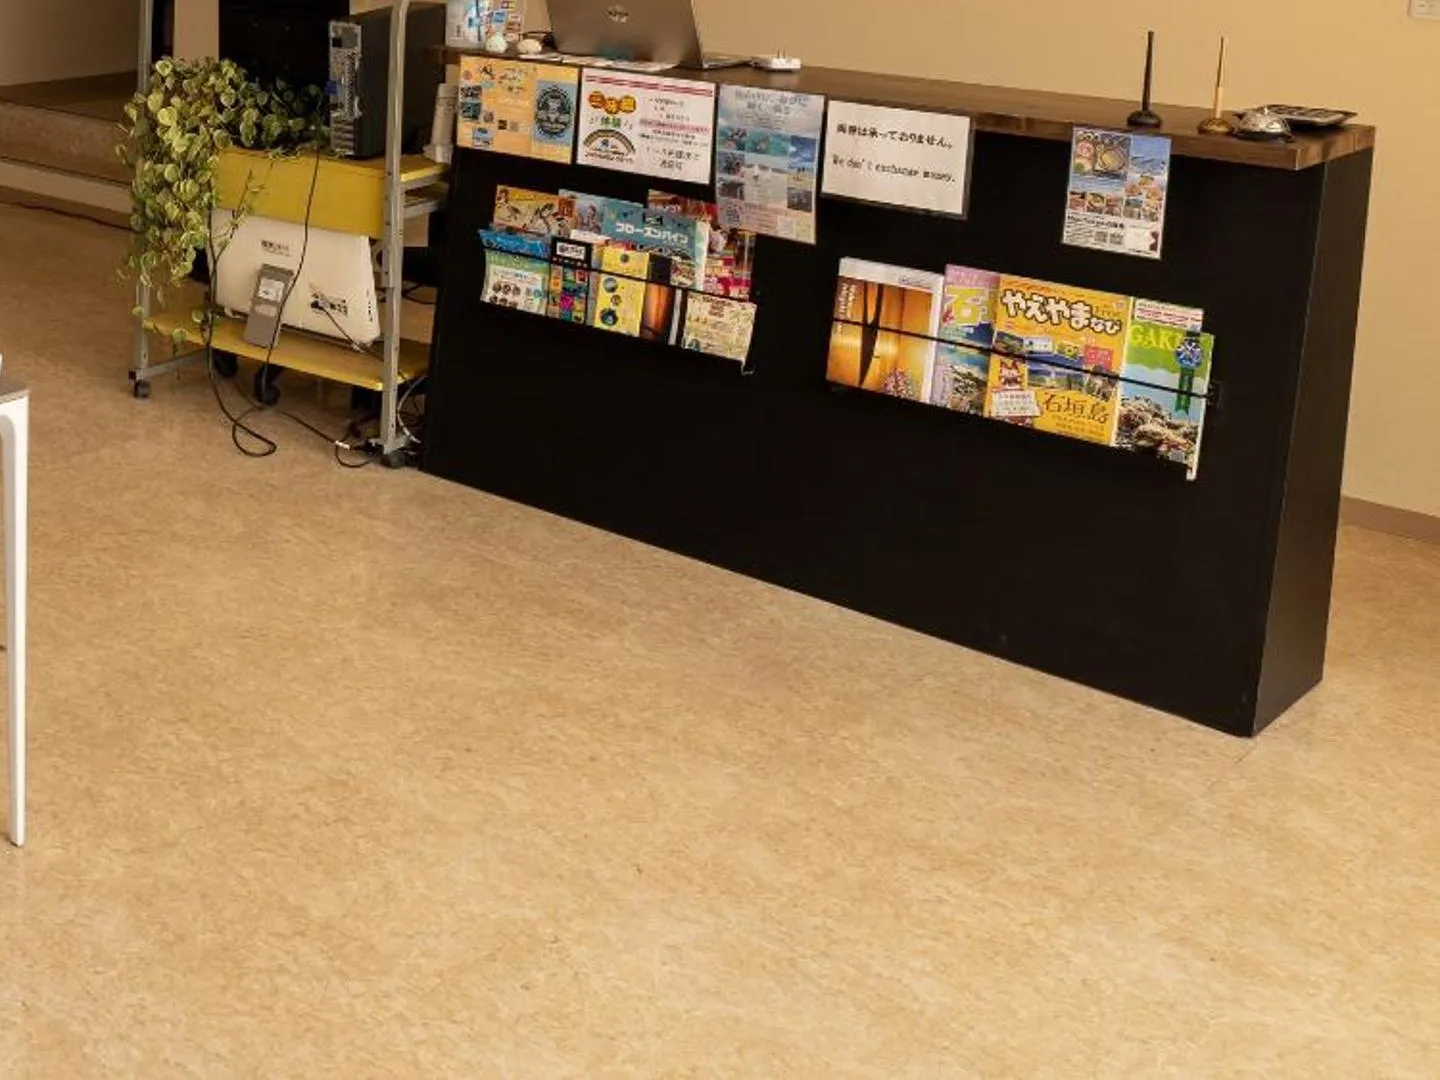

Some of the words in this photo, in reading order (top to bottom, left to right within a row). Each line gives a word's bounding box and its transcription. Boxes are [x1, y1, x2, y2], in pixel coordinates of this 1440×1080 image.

[1001, 288, 1122, 335] やえやまなび
[1043, 391, 1110, 424] 石垣島
